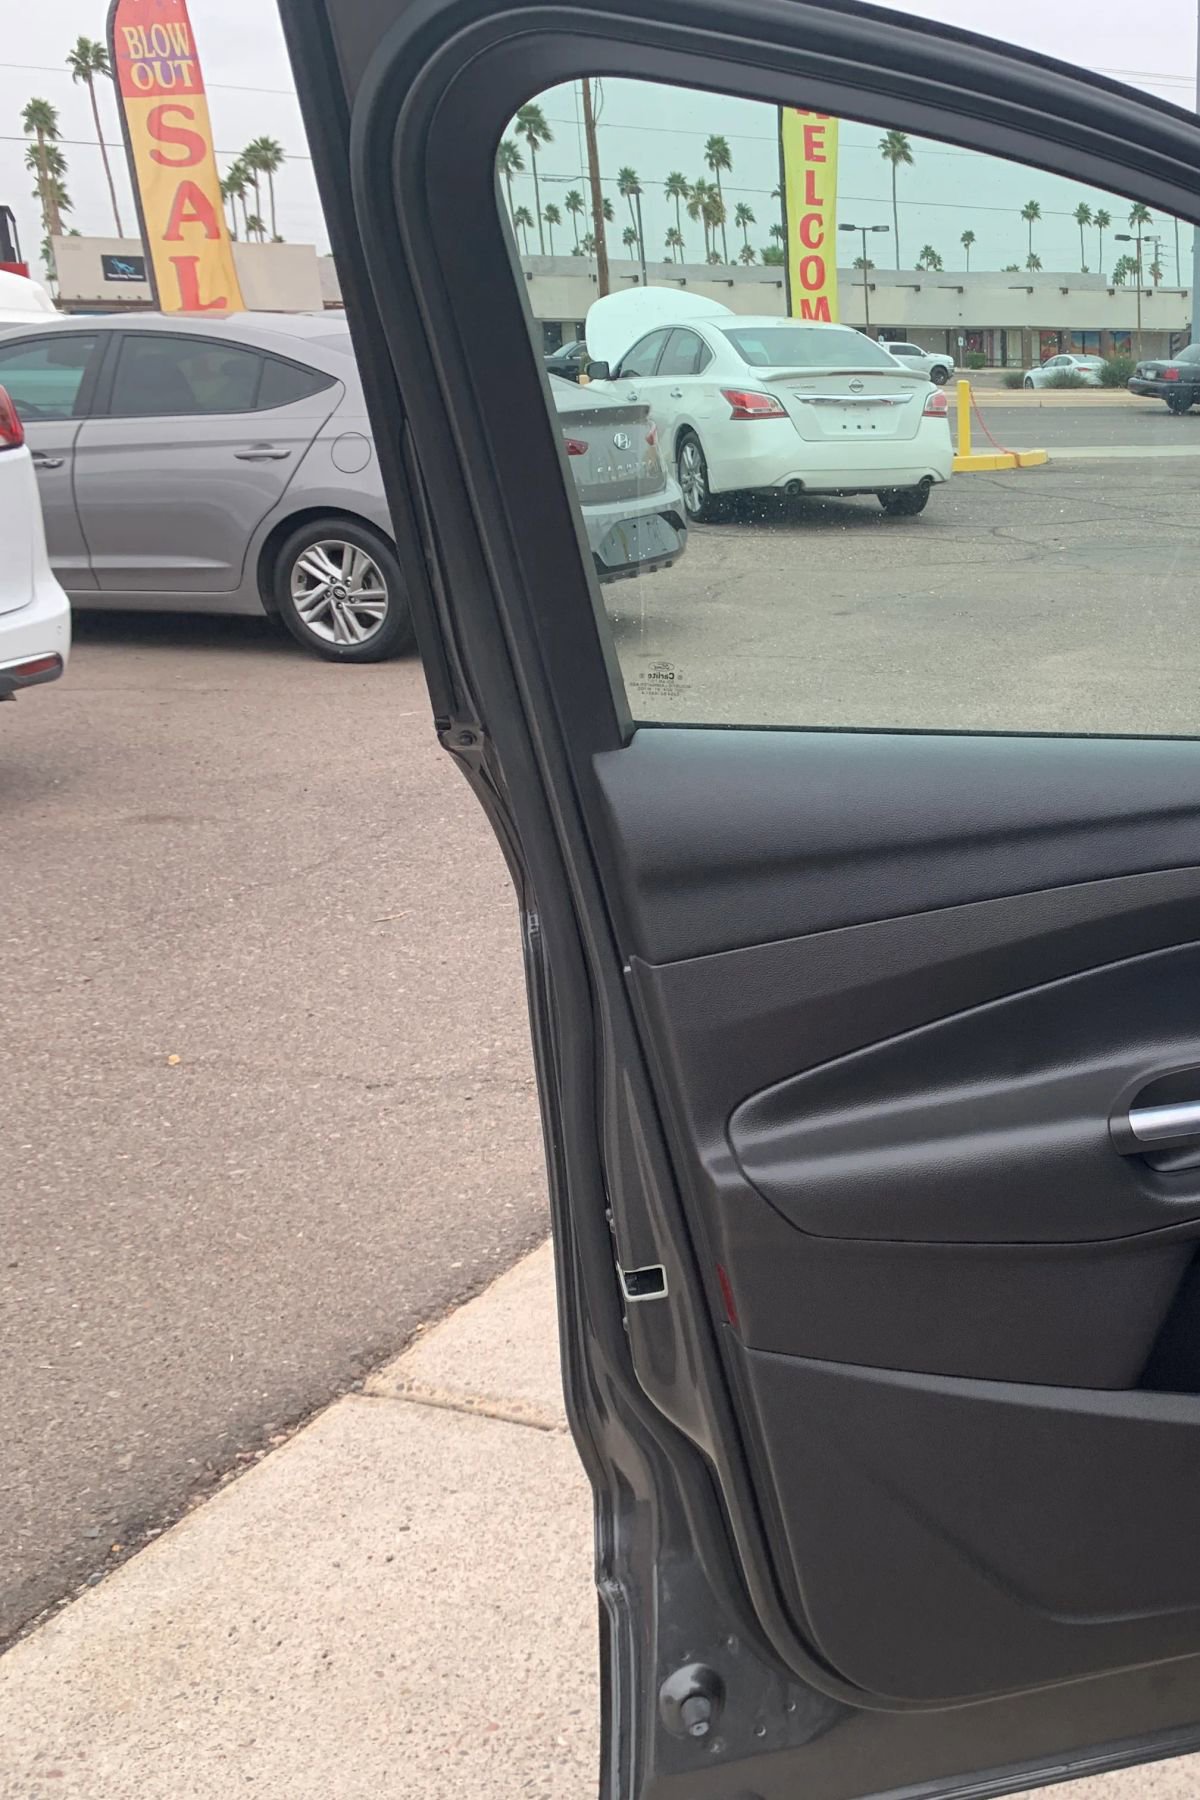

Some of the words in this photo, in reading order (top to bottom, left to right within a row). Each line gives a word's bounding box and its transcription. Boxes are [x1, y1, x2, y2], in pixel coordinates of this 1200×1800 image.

[121, 22, 190, 59] BLOW
[131, 60, 194, 90] OUT
[147, 104, 228, 311] SAL
[797, 109, 832, 323] ELCOM
